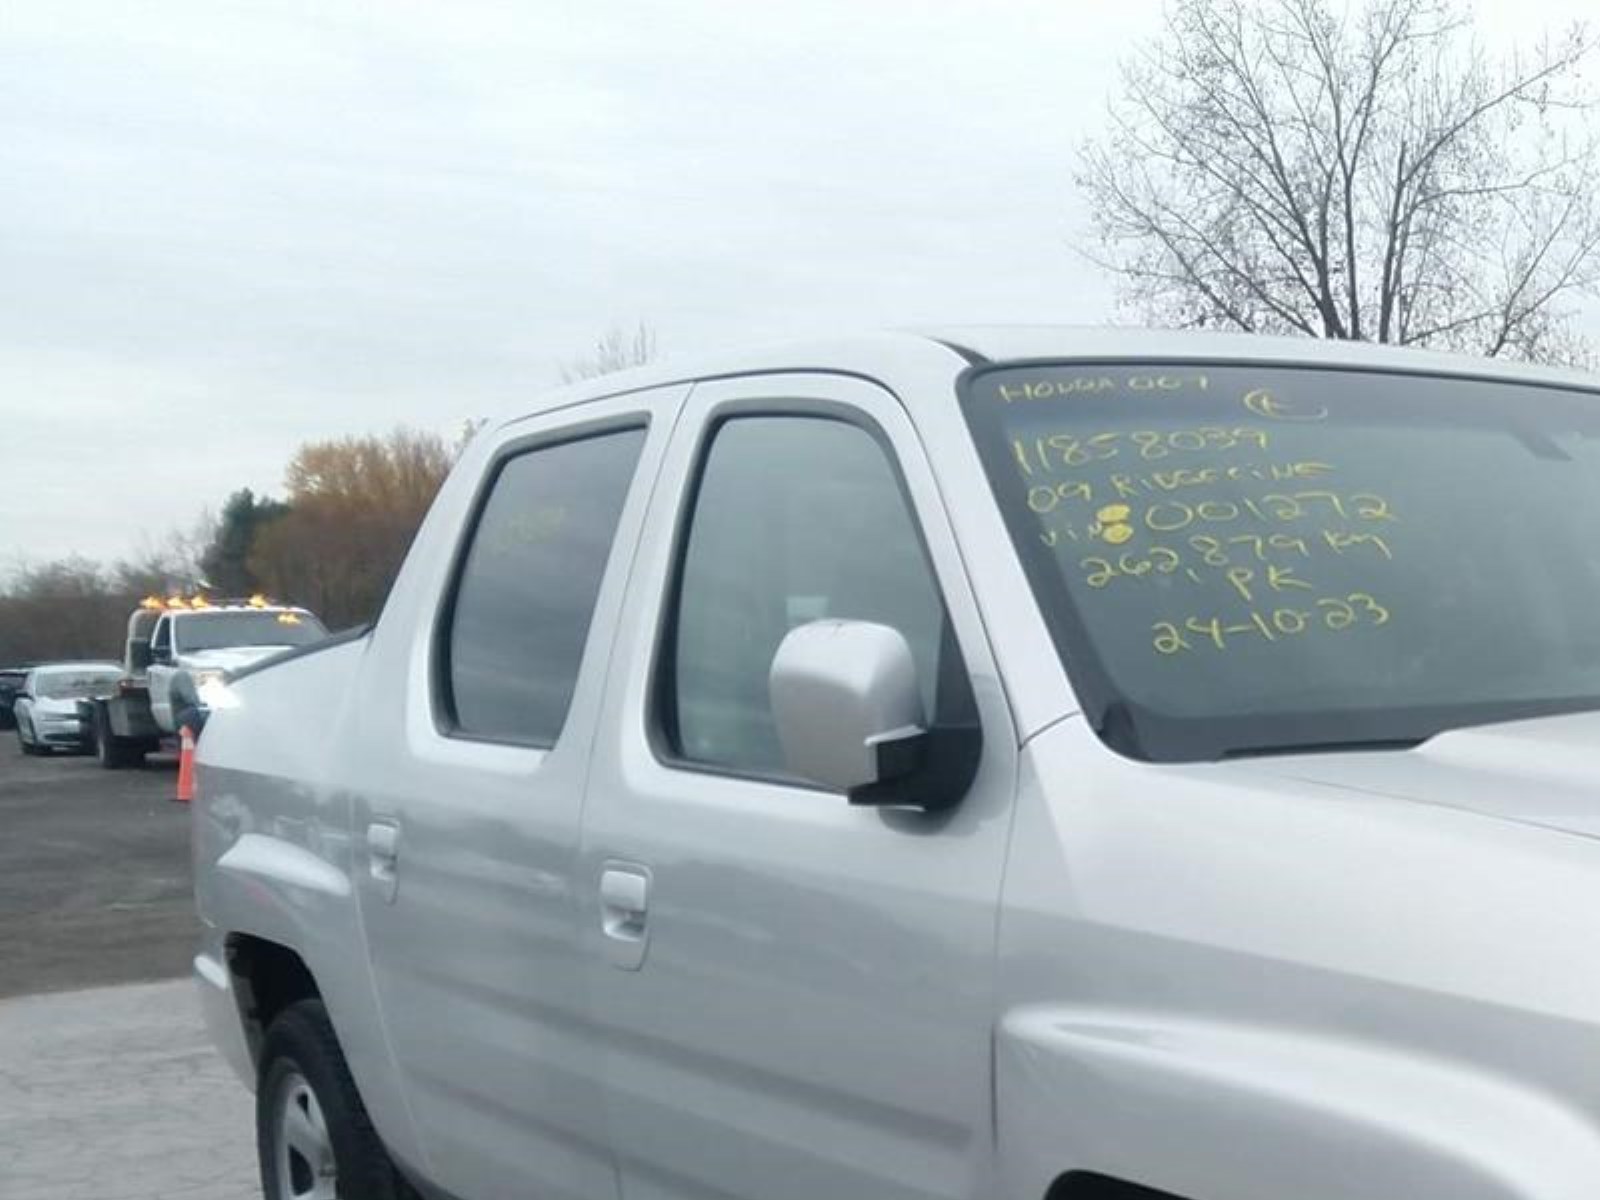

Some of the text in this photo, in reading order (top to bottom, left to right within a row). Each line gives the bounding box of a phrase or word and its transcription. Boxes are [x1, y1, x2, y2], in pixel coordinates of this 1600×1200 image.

[1014, 428, 1270, 475] 11858039
[1028, 484, 1091, 512] 09
[1145, 491, 1394, 531] 001272
